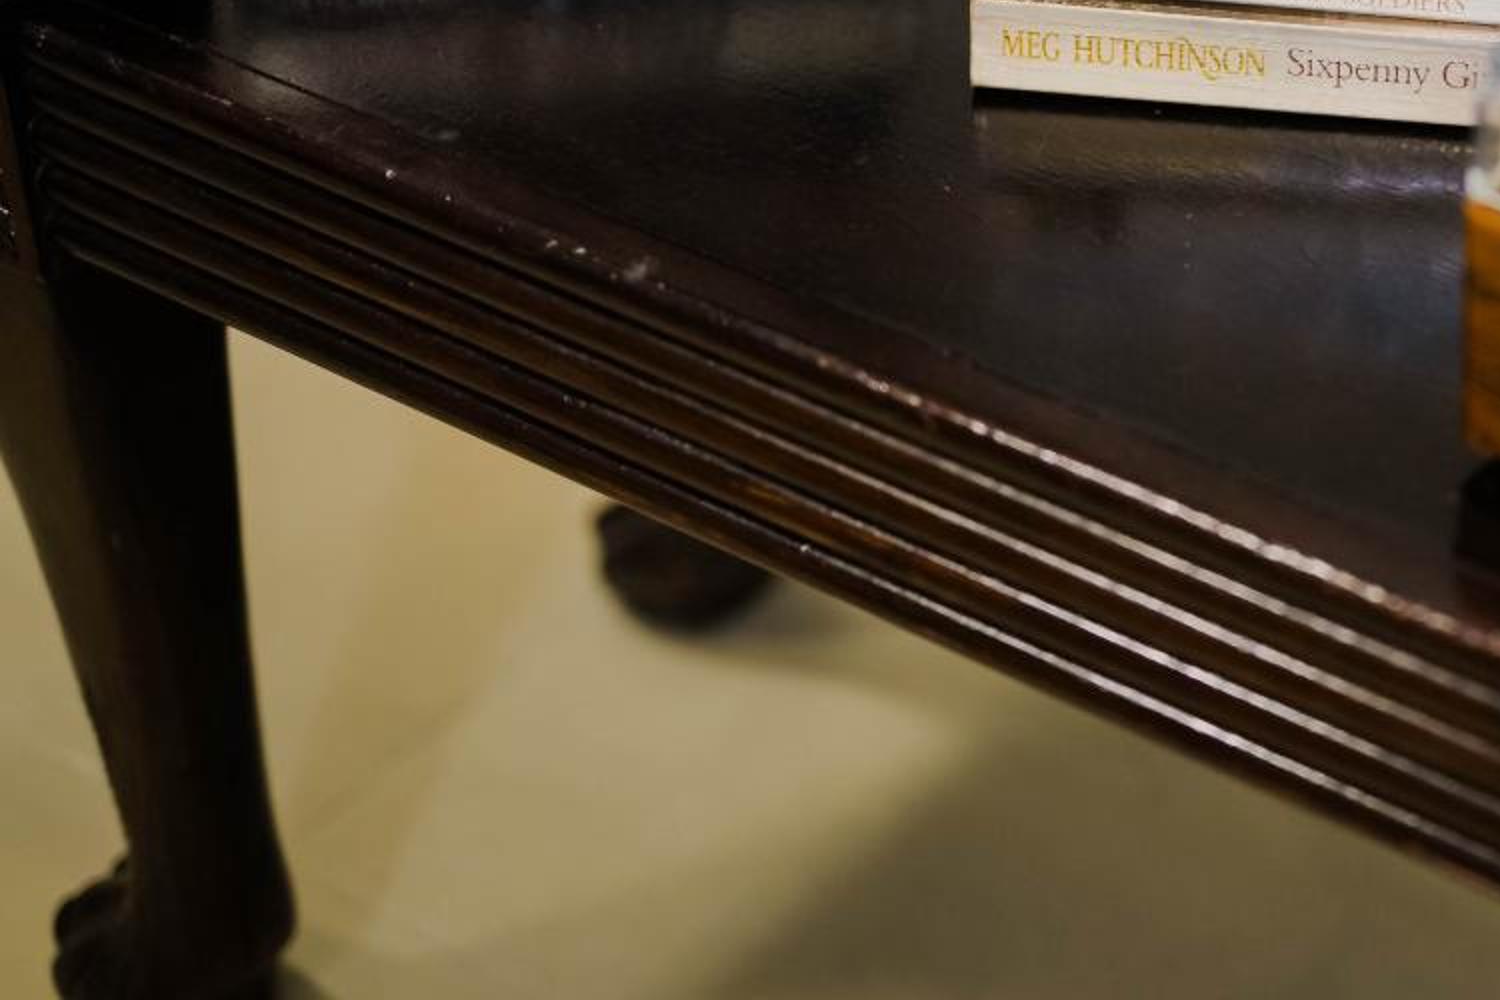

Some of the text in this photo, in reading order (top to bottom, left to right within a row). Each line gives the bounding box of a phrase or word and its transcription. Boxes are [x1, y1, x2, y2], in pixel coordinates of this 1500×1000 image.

[1001, 28, 1266, 82] MEG HUTCHINSON
[1287, 47, 1487, 95] Sixpenny Gi
